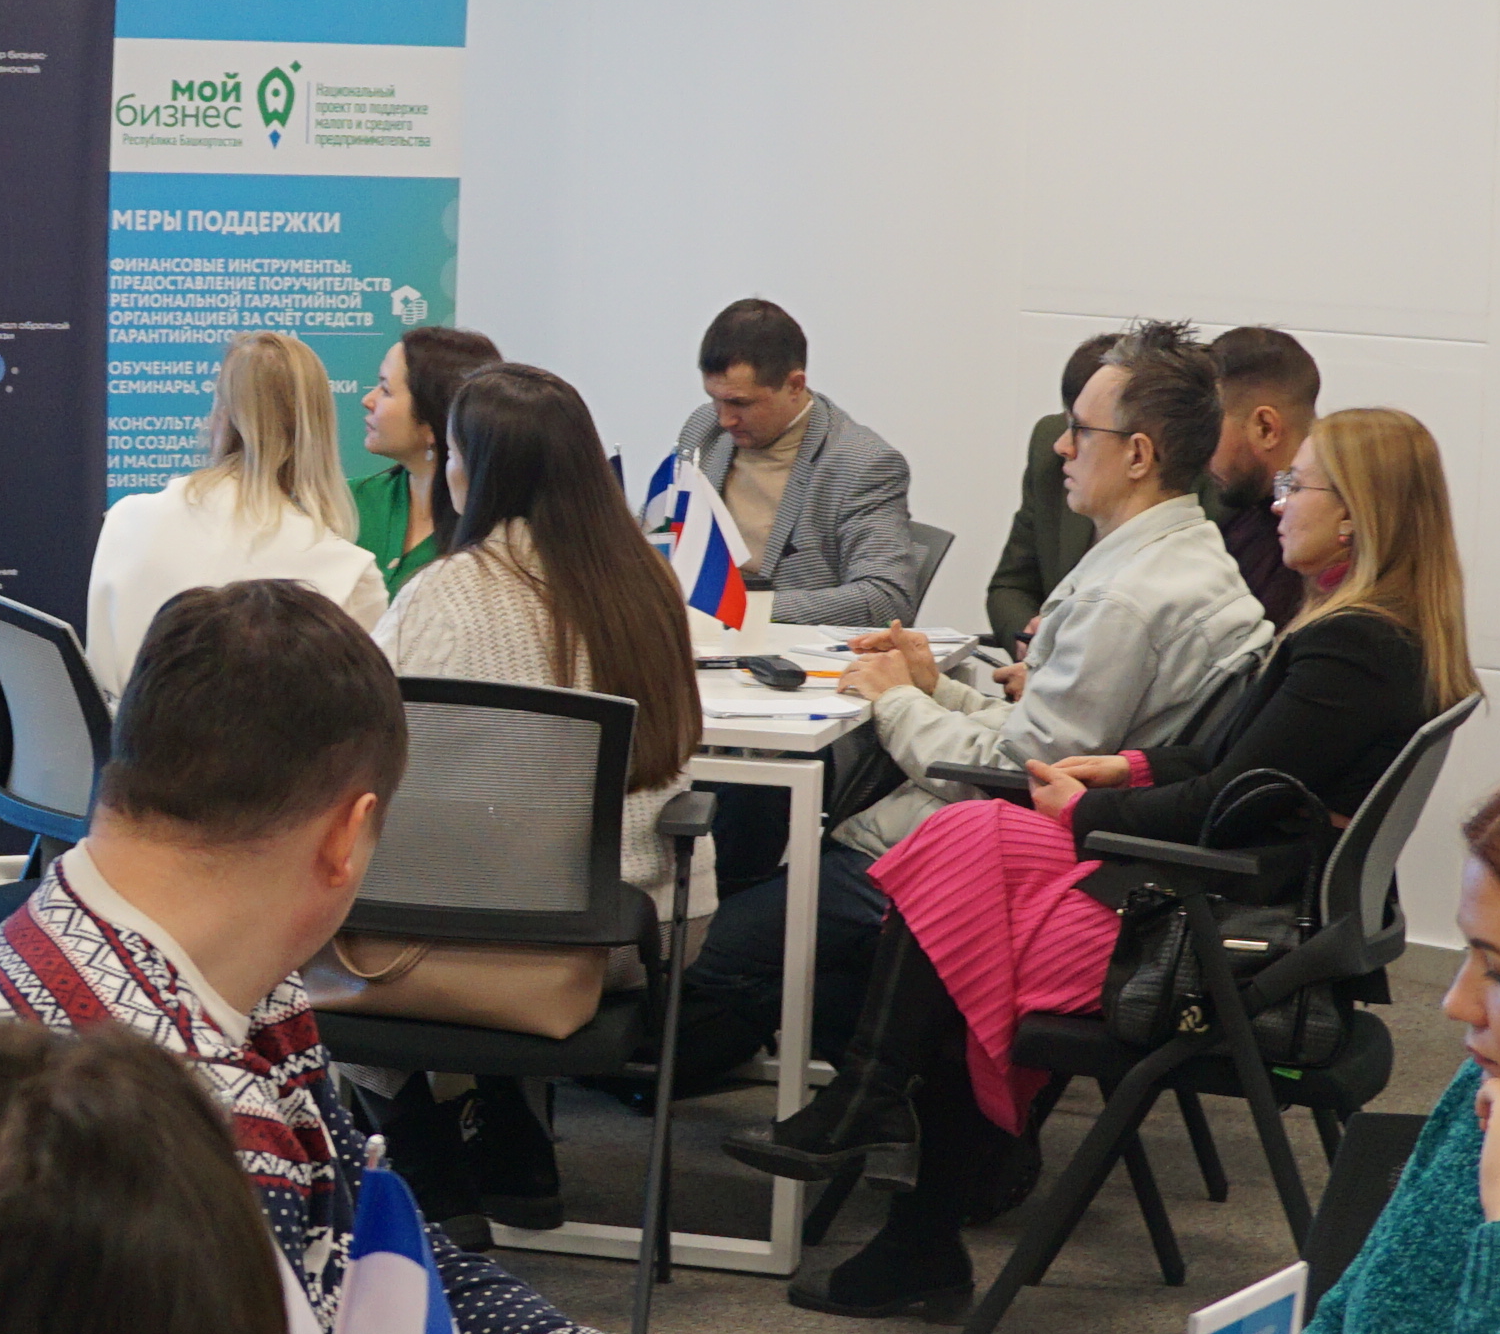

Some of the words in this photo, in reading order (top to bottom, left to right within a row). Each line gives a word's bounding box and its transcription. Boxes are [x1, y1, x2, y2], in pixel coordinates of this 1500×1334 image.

[171, 72, 243, 103] мой
[316, 83, 396, 99] Национальный
[116, 93, 243, 128] бизнес
[316, 103, 351, 116] проект
[316, 119, 353, 131] малого
[111, 209, 182, 232] МЕРЫ
[187, 210, 341, 235] ПОДДЕРЖКИ
[110, 257, 225, 273] ФИНАНСОВЫЕ
[227, 258, 353, 274] ИНСТРУМЕНТЫ:
[110, 275, 256, 292] ПРЕДОСТАВЛЕНИЕ
[258, 276, 392, 292] ПОРУЧИТЕЛЬСТВ
[110, 290, 242, 309] РЕГИОНАЛЬНОЙ
[244, 290, 363, 309] ГАРАНТИЙНОЙ
[110, 309, 240, 327] ОРГАНИЗАЦИЕЙ
[241, 311, 263, 326] ЗА
[264, 308, 303, 326] СЧЁТ
[304, 312, 374, 327] СРЕДСТВ
[108, 361, 194, 376] ОБУЧЕНИЕ
[196, 361, 209, 376] И
[107, 379, 199, 396] СЕМИНАРЫ,
[107, 436, 134, 450] ПО
[107, 455, 121, 469] И
